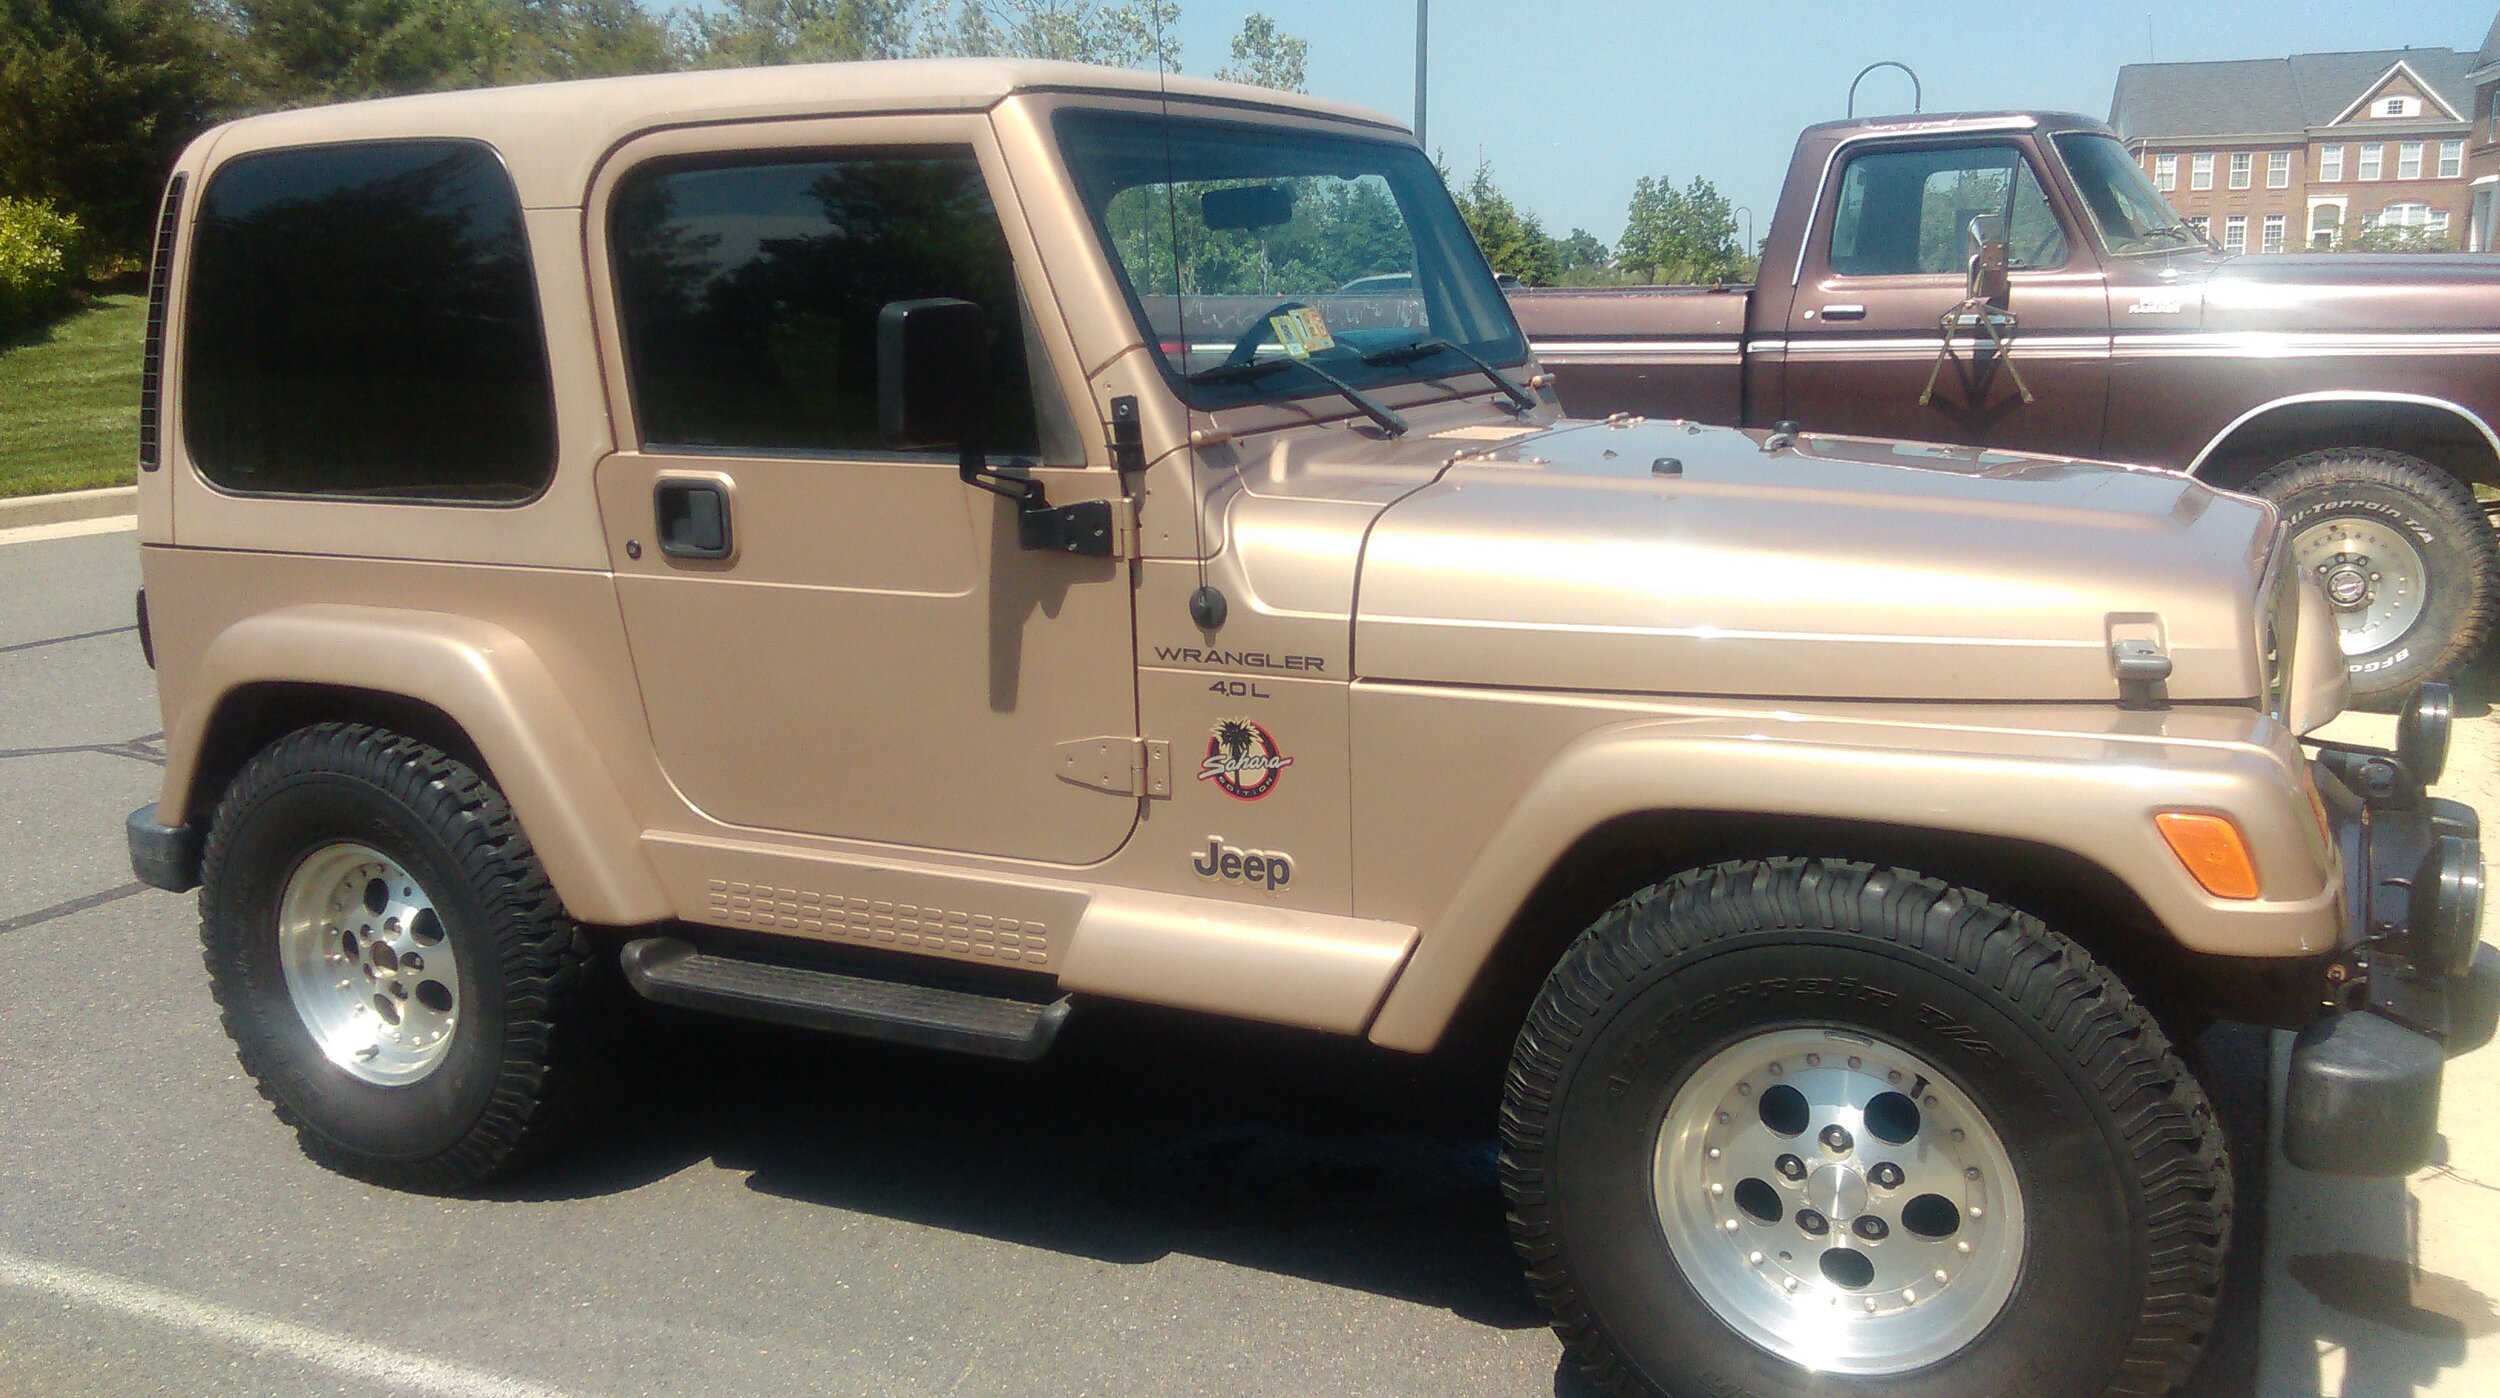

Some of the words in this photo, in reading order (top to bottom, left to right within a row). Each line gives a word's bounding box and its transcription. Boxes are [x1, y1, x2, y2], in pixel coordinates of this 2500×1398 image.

[2289, 499, 2402, 526] ll-Terrain
[1154, 646, 1325, 672] WRANGLER
[1199, 749, 1293, 779] Sahara
[1218, 775, 1273, 797] EDITION
[1192, 838, 1292, 891] Jeep
